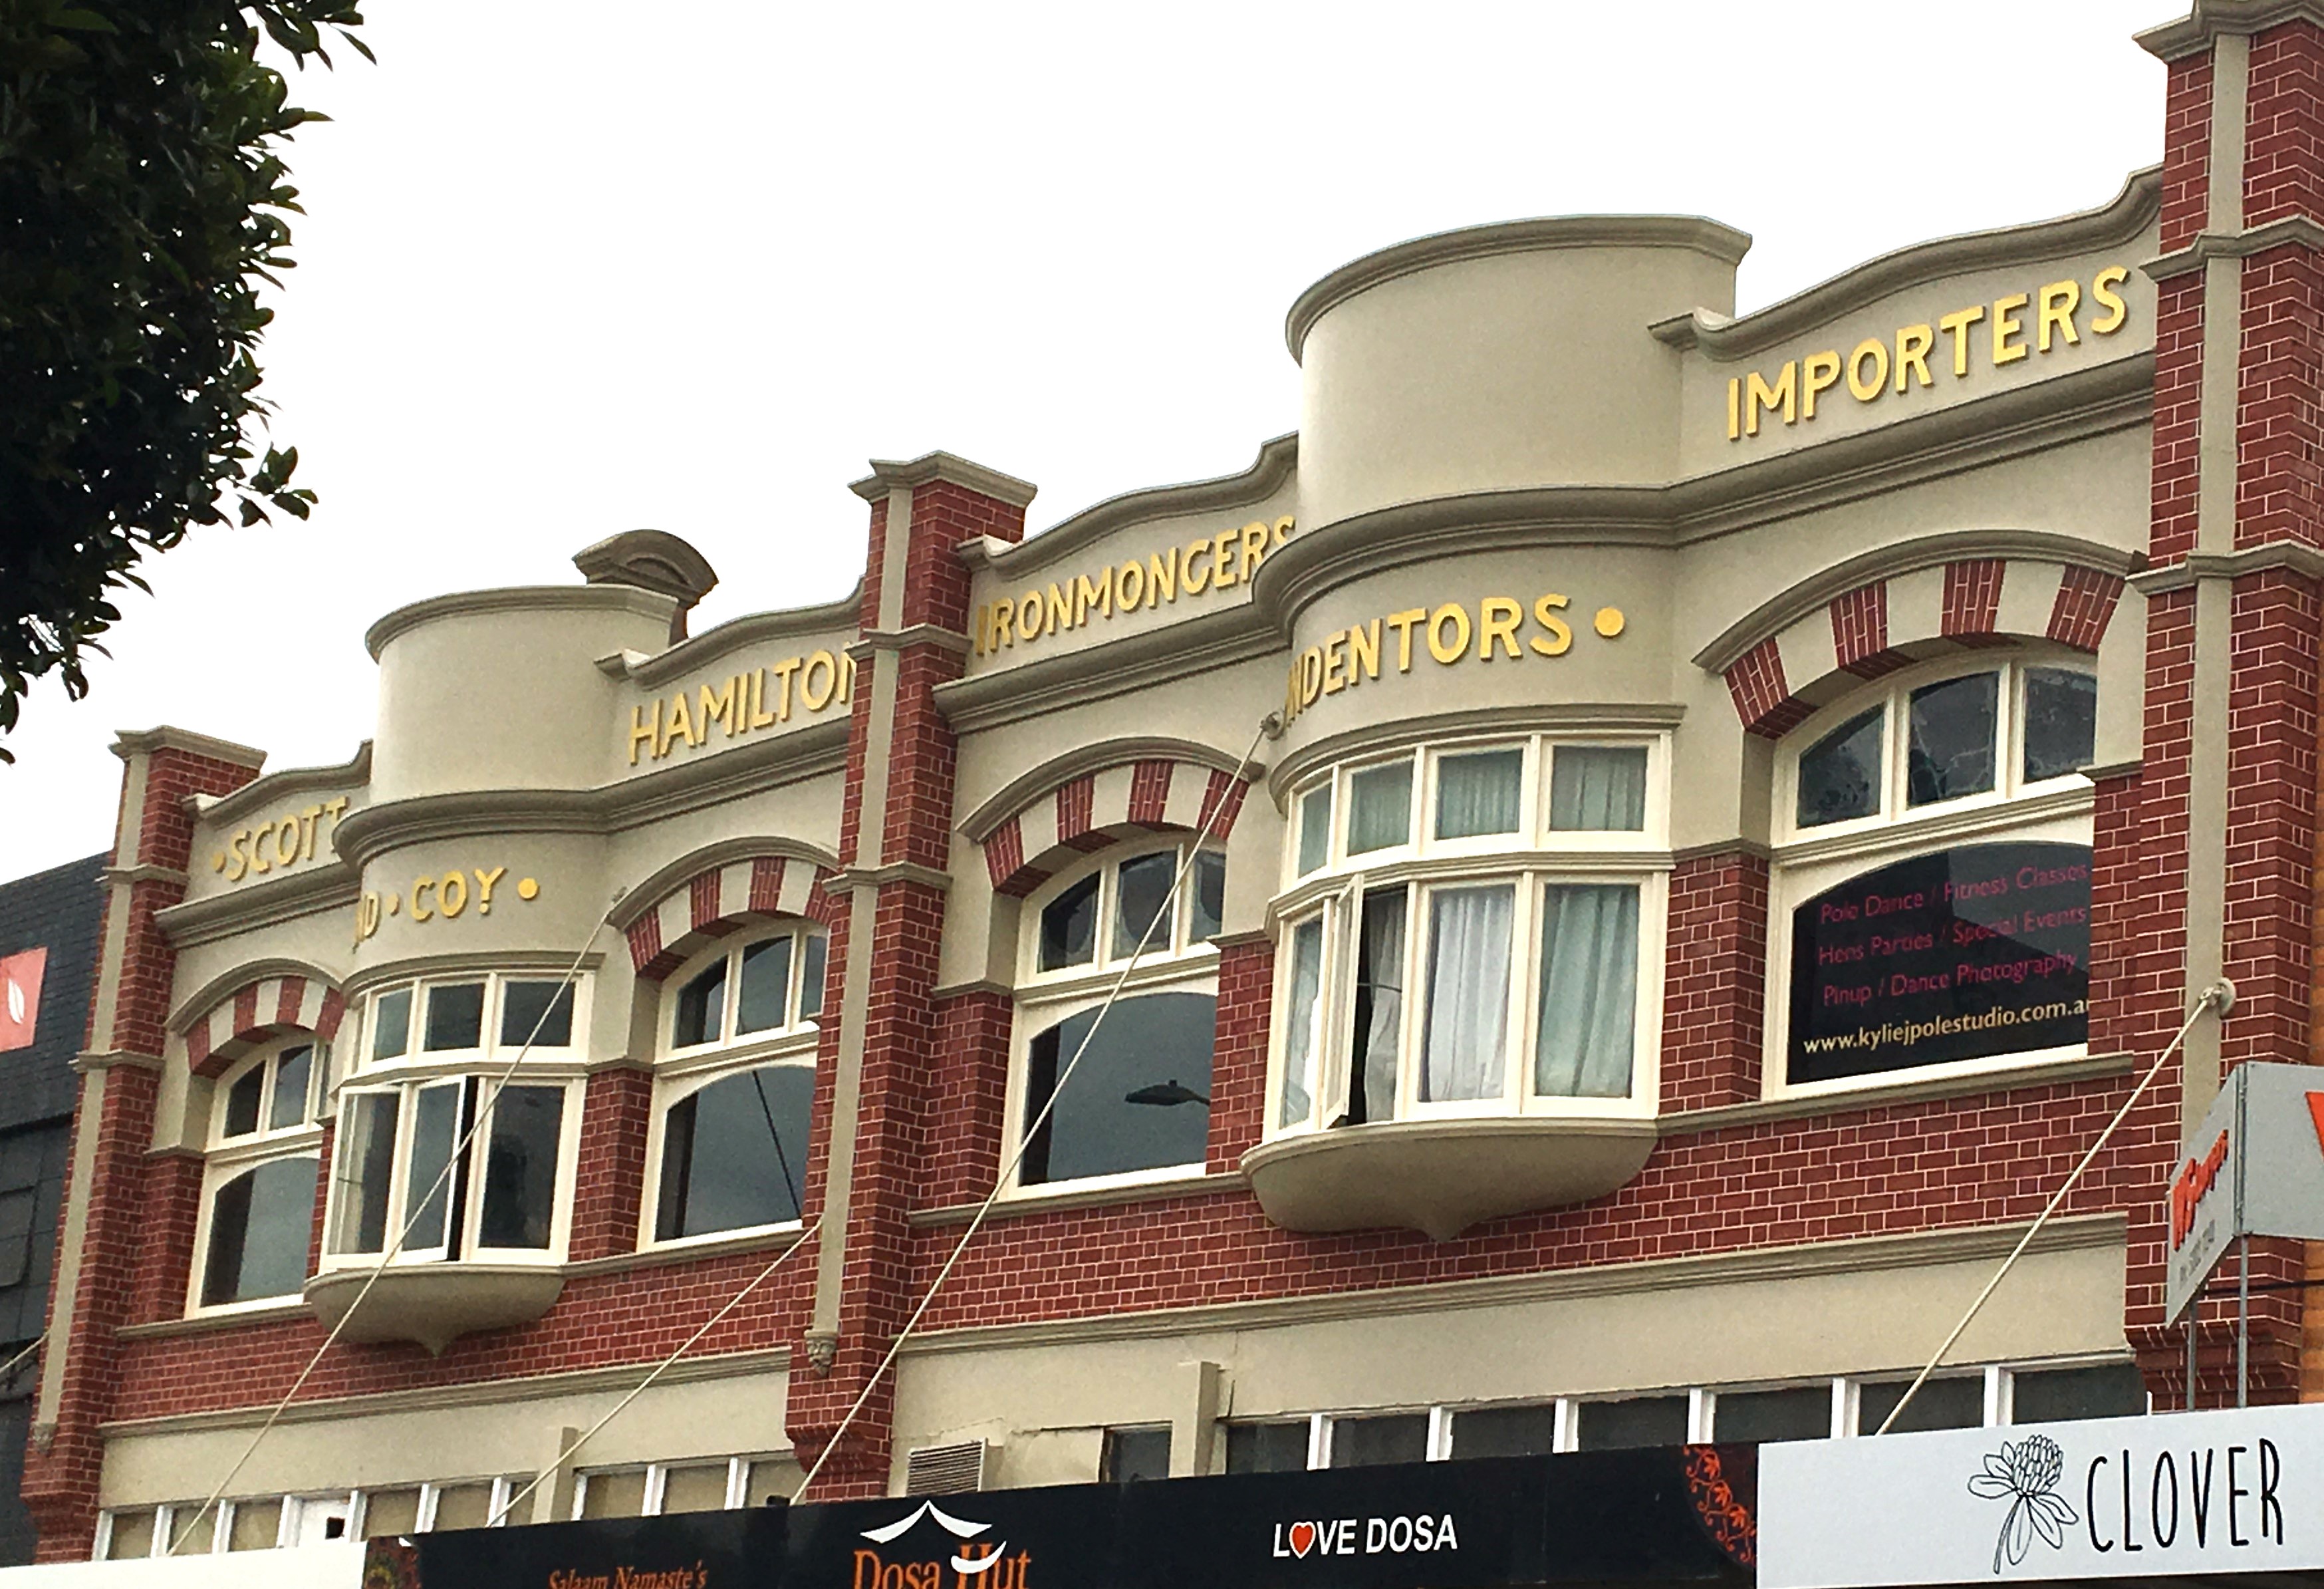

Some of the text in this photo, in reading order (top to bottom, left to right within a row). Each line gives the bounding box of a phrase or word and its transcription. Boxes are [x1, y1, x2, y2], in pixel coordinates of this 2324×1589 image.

[1729, 263, 2130, 440] IMPORTERS
[629, 641, 856, 765] HAMILTON
[1821, 902, 1859, 924] Pole
[1865, 892, 1923, 917] Dance
[1944, 878, 2008, 902] Fitness
[2015, 864, 2088, 889] Classes
[1819, 943, 1865, 965] Hens
[1871, 933, 1934, 956] Parties
[1952, 914, 2018, 947] Special
[2023, 906, 2087, 933] Events
[1824, 984, 1871, 1007] Pinup
[1890, 974, 1950, 996] Dance
[1957, 950, 2077, 987] Photography
[2087, 1437, 2283, 1552] CLOVER
[1366, 1514, 1458, 1553] DOSA
[854, 1542, 1032, 1589] Dosa Hut
